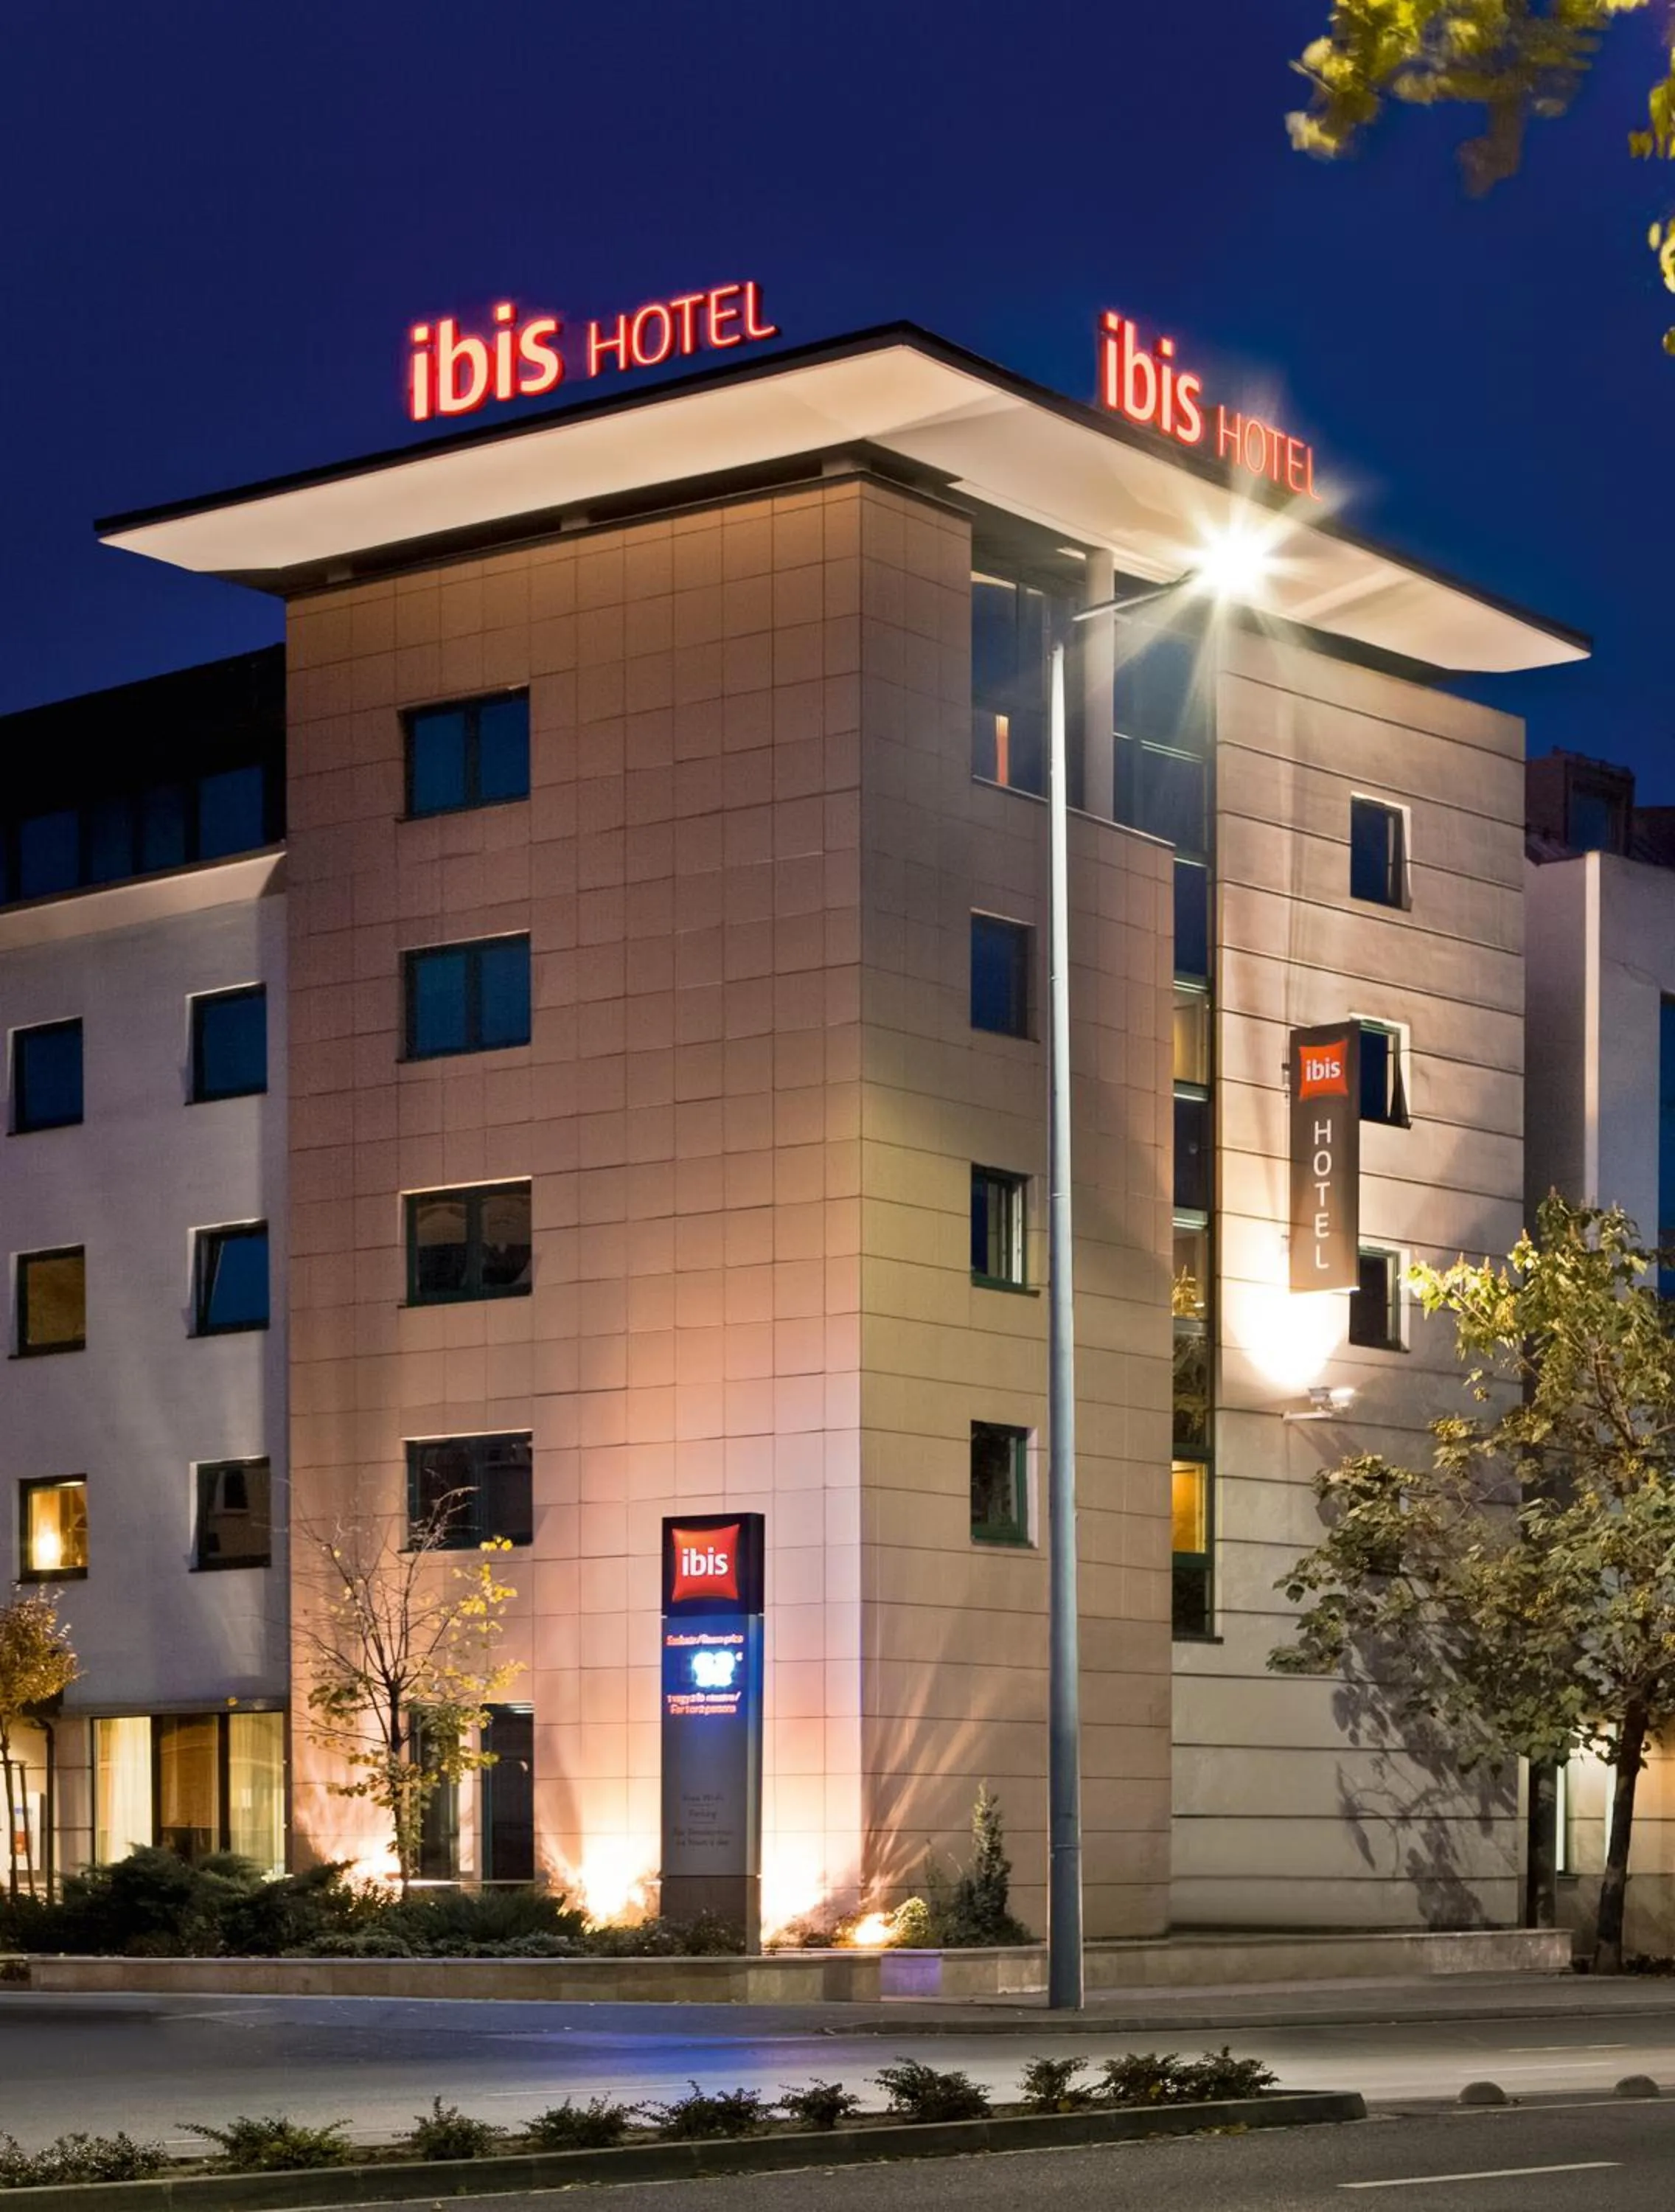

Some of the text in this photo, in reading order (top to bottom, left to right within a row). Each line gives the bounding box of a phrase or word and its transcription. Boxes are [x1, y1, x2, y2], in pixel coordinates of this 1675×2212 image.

[410, 281, 777, 421] ibis HOTEL
[1101, 310, 1321, 501] ibis HOTEL
[1305, 1057, 1341, 1082] ibis
[1313, 1119, 1332, 1269] HOTEL
[682, 1546, 728, 1577] ibis
